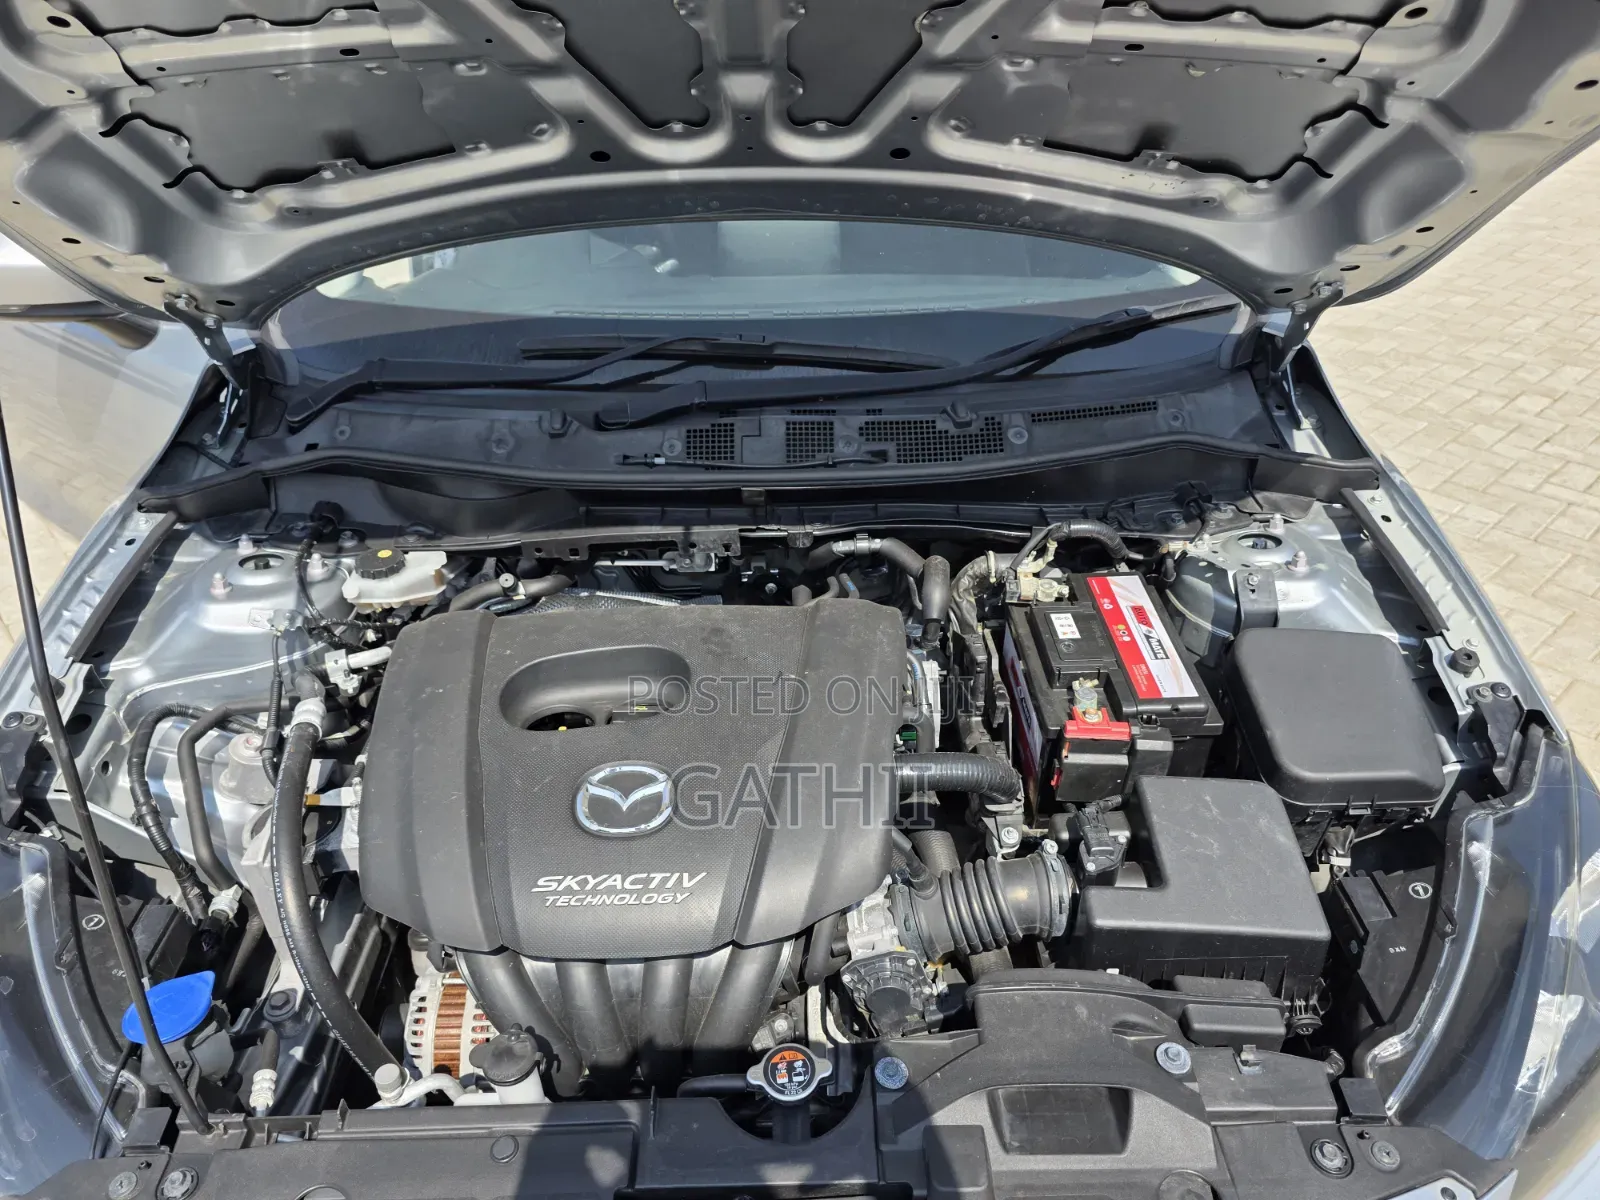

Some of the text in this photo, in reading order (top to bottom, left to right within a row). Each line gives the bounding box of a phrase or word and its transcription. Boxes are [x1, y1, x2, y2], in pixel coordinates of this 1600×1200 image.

[1134, 607, 1148, 626] AUTO
[1148, 638, 1167, 659] MATE
[273, 871, 284, 904] GALAXY
[531, 872, 707, 893] SKYACTIV
[544, 892, 692, 907] TECHNOLOGY
